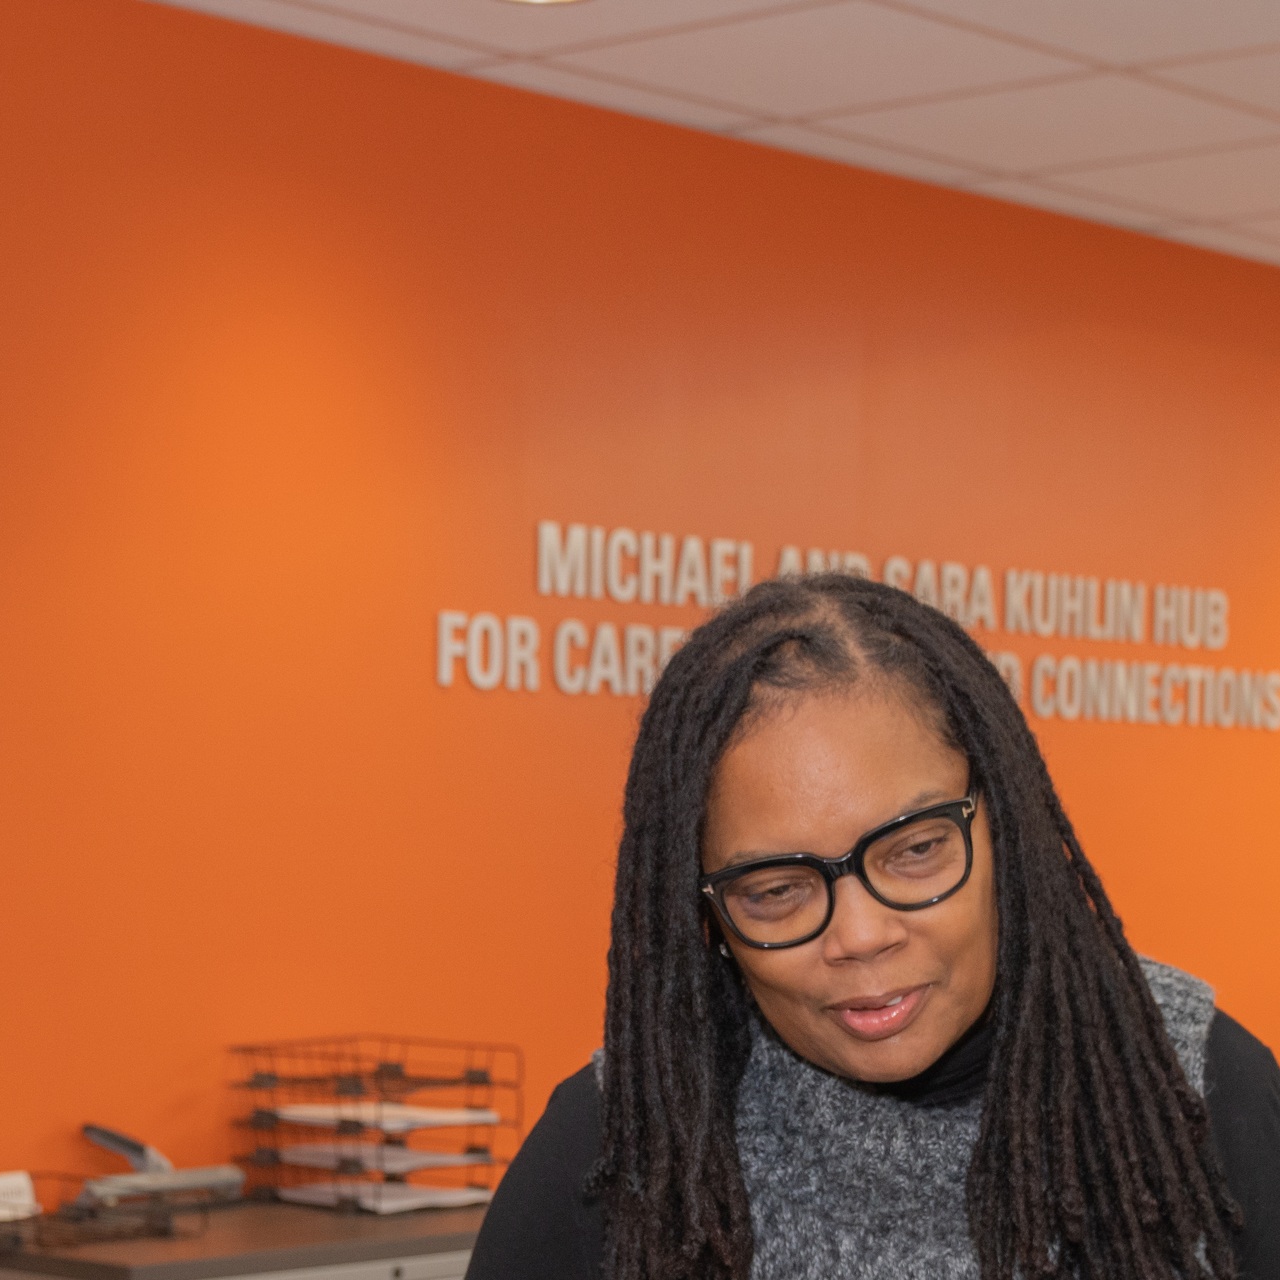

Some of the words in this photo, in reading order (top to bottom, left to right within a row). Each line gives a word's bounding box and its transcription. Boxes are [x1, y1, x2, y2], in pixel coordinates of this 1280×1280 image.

[436, 609, 541, 692] FOR
[1004, 567, 1146, 644] KUHLIN
[1153, 582, 1231, 651] HUB
